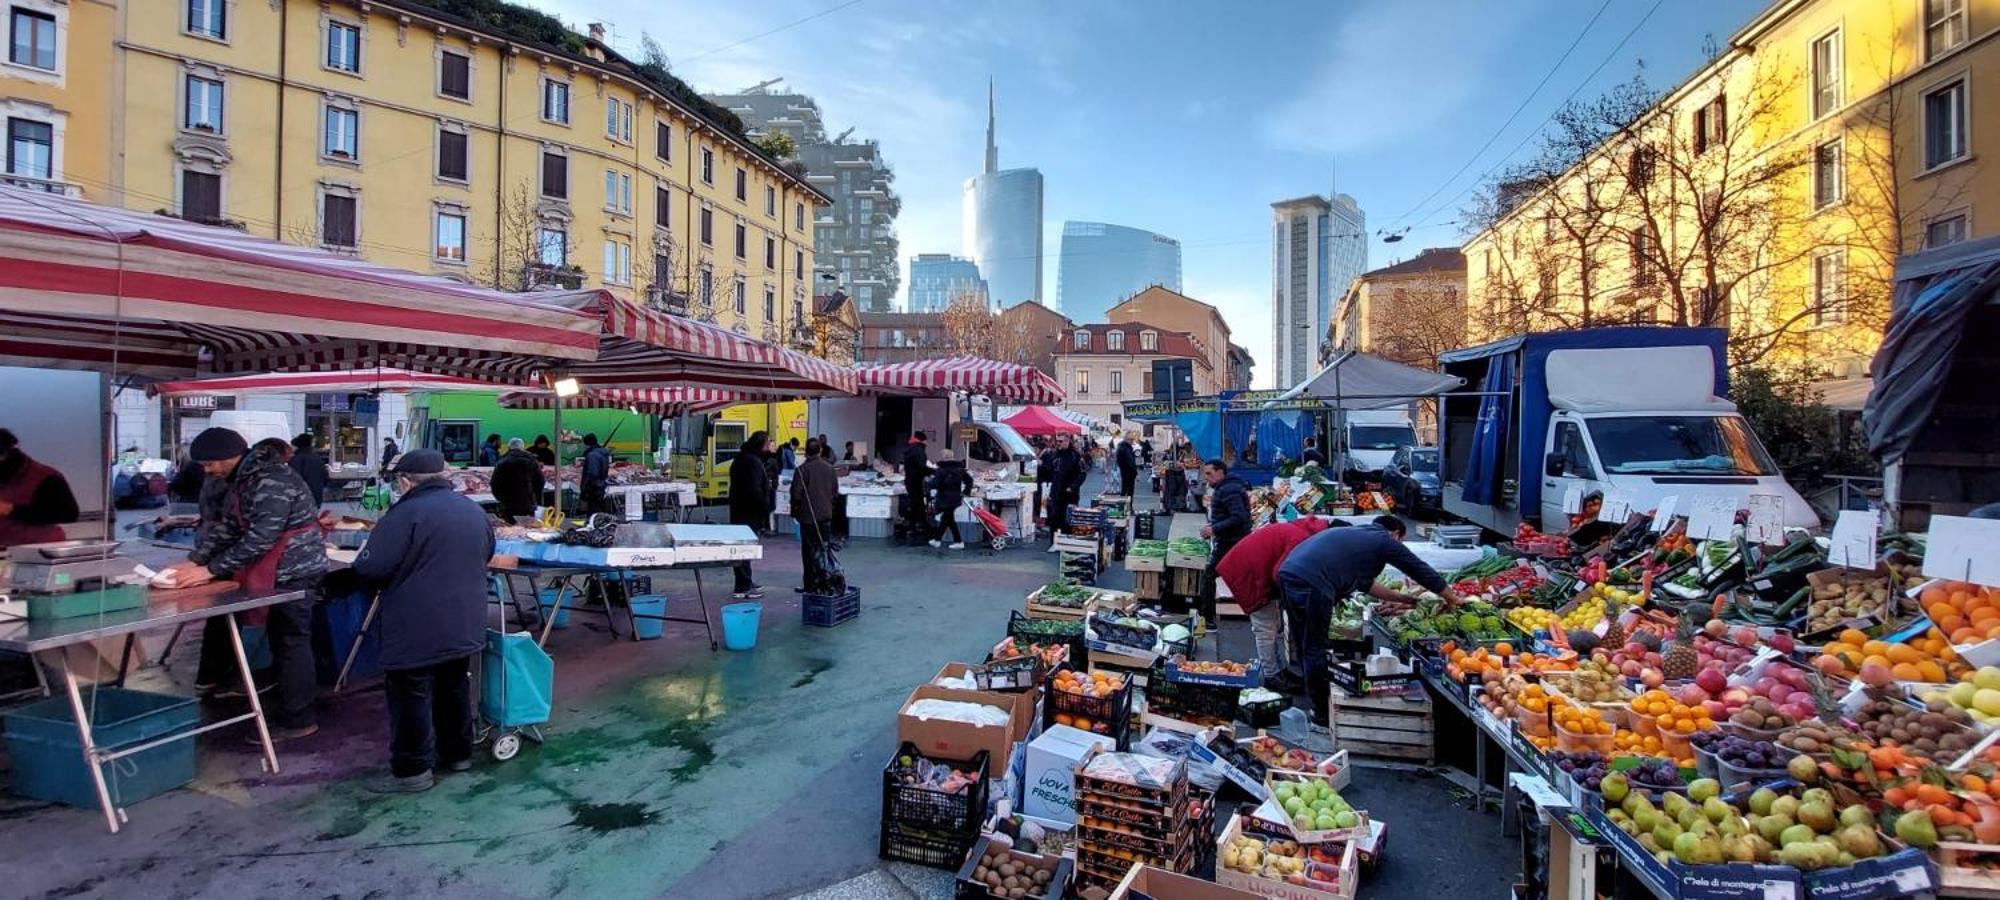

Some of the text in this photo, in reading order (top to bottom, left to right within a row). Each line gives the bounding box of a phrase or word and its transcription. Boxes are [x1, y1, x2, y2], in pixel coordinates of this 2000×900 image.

[1039, 776, 1070, 793] UOVA
[1683, 876, 1765, 891] Mela di montagna
[1811, 884, 1840, 896] Mela
[1840, 881, 1850, 891] di
